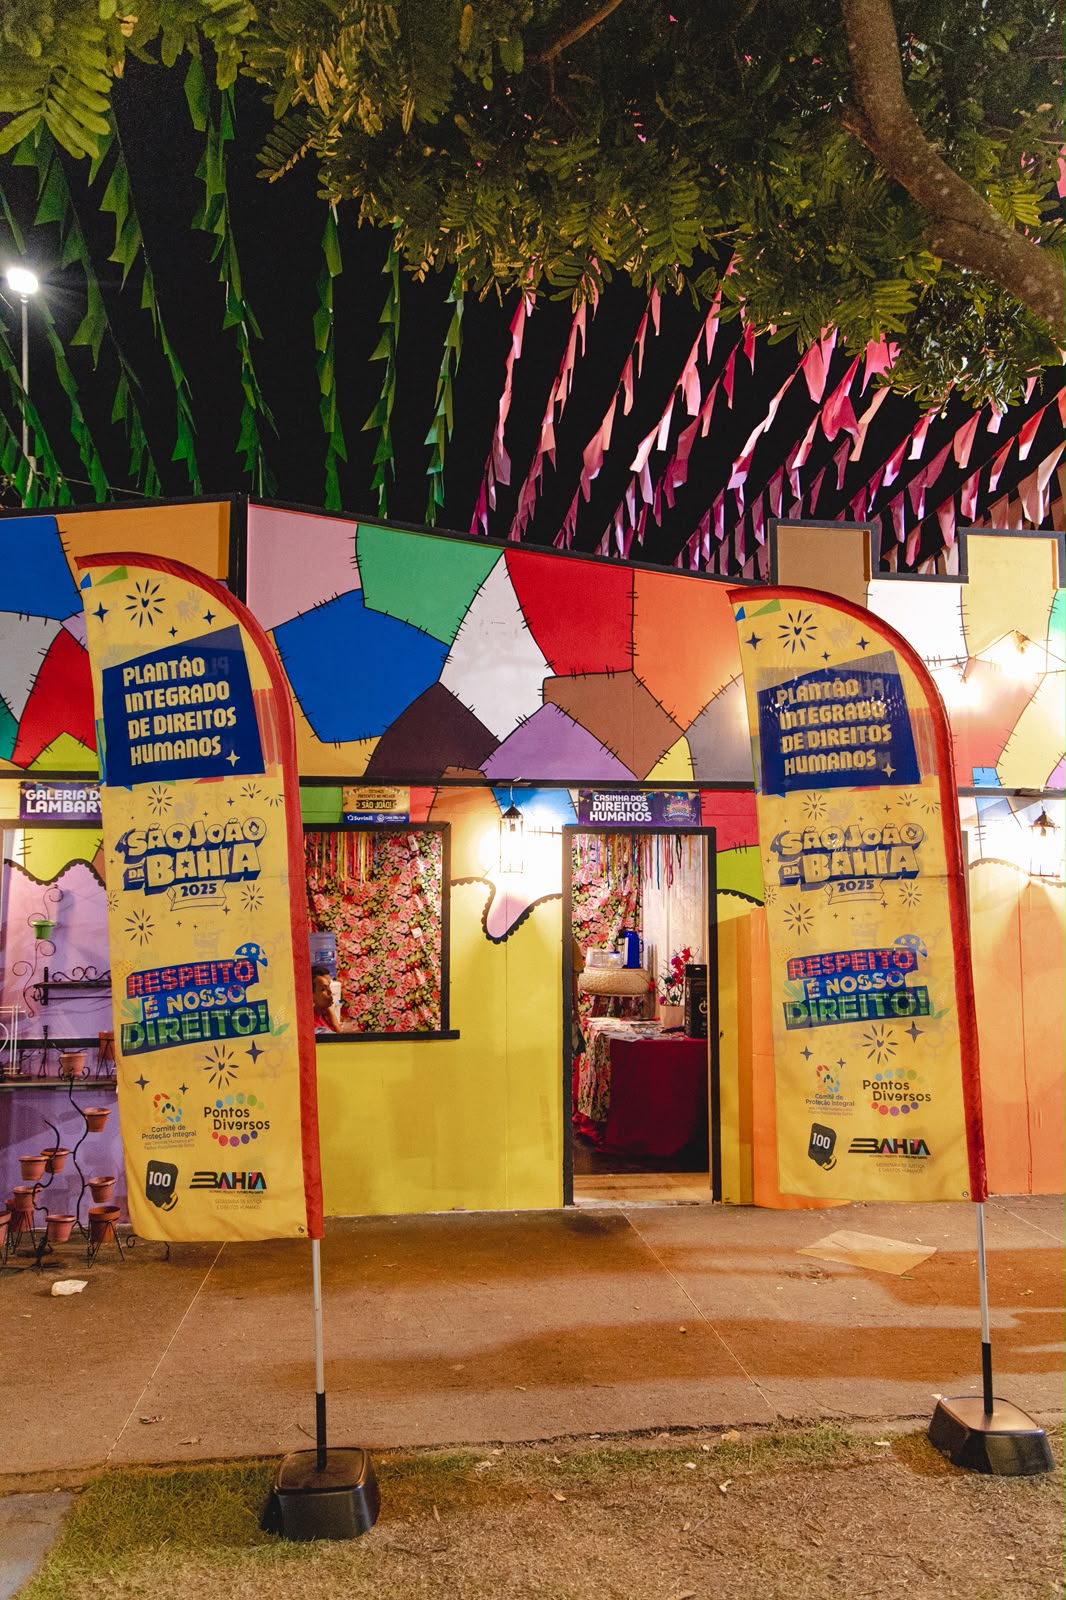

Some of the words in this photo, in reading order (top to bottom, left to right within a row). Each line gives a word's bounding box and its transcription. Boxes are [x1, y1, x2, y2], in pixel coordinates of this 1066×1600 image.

[123, 656, 205, 687] PLANTÃO
[124, 680, 230, 713] INTEGRADO
[776, 677, 859, 704] PLANTÃO
[128, 716, 150, 740] DE
[153, 706, 237, 735] DIREITOS
[780, 701, 886, 730] INTEGRADO
[130, 736, 222, 766] HUMANOS
[782, 733, 804, 753] DE
[807, 724, 893, 748] DIREITOS
[784, 749, 877, 776] HUMANOS
[25, 789, 87, 800] GALERIA
[361, 799, 374, 809] SÃO
[593, 802, 649, 812] DIREITOS
[594, 794, 630, 802] CASINHA
[630, 794, 647, 802] DOS
[589, 811, 652, 822] HUMANOS
[145, 843, 261, 892] BAHIA
[801, 846, 919, 888] BAHIA
[180, 883, 217, 897] 2025
[837, 879, 874, 893] 2025
[788, 949, 914, 979] RESPEITO
[127, 960, 254, 996] RESPEITO
[826, 970, 904, 996] NOSSO
[166, 984, 245, 1014] NOSSO
[786, 990, 929, 1025] DIREITO!
[123, 1004, 268, 1050] DIREITO!
[862, 1079, 910, 1091] Pontos
[872, 1091, 931, 1102] Diversos
[204, 1106, 250, 1118] Pontos
[213, 1119, 270, 1130] Diversos
[812, 1132, 831, 1149] 100
[848, 1138, 931, 1155] BAHIA
[149, 1171, 171, 1188] 100
[189, 1171, 267, 1189] BAHIA
